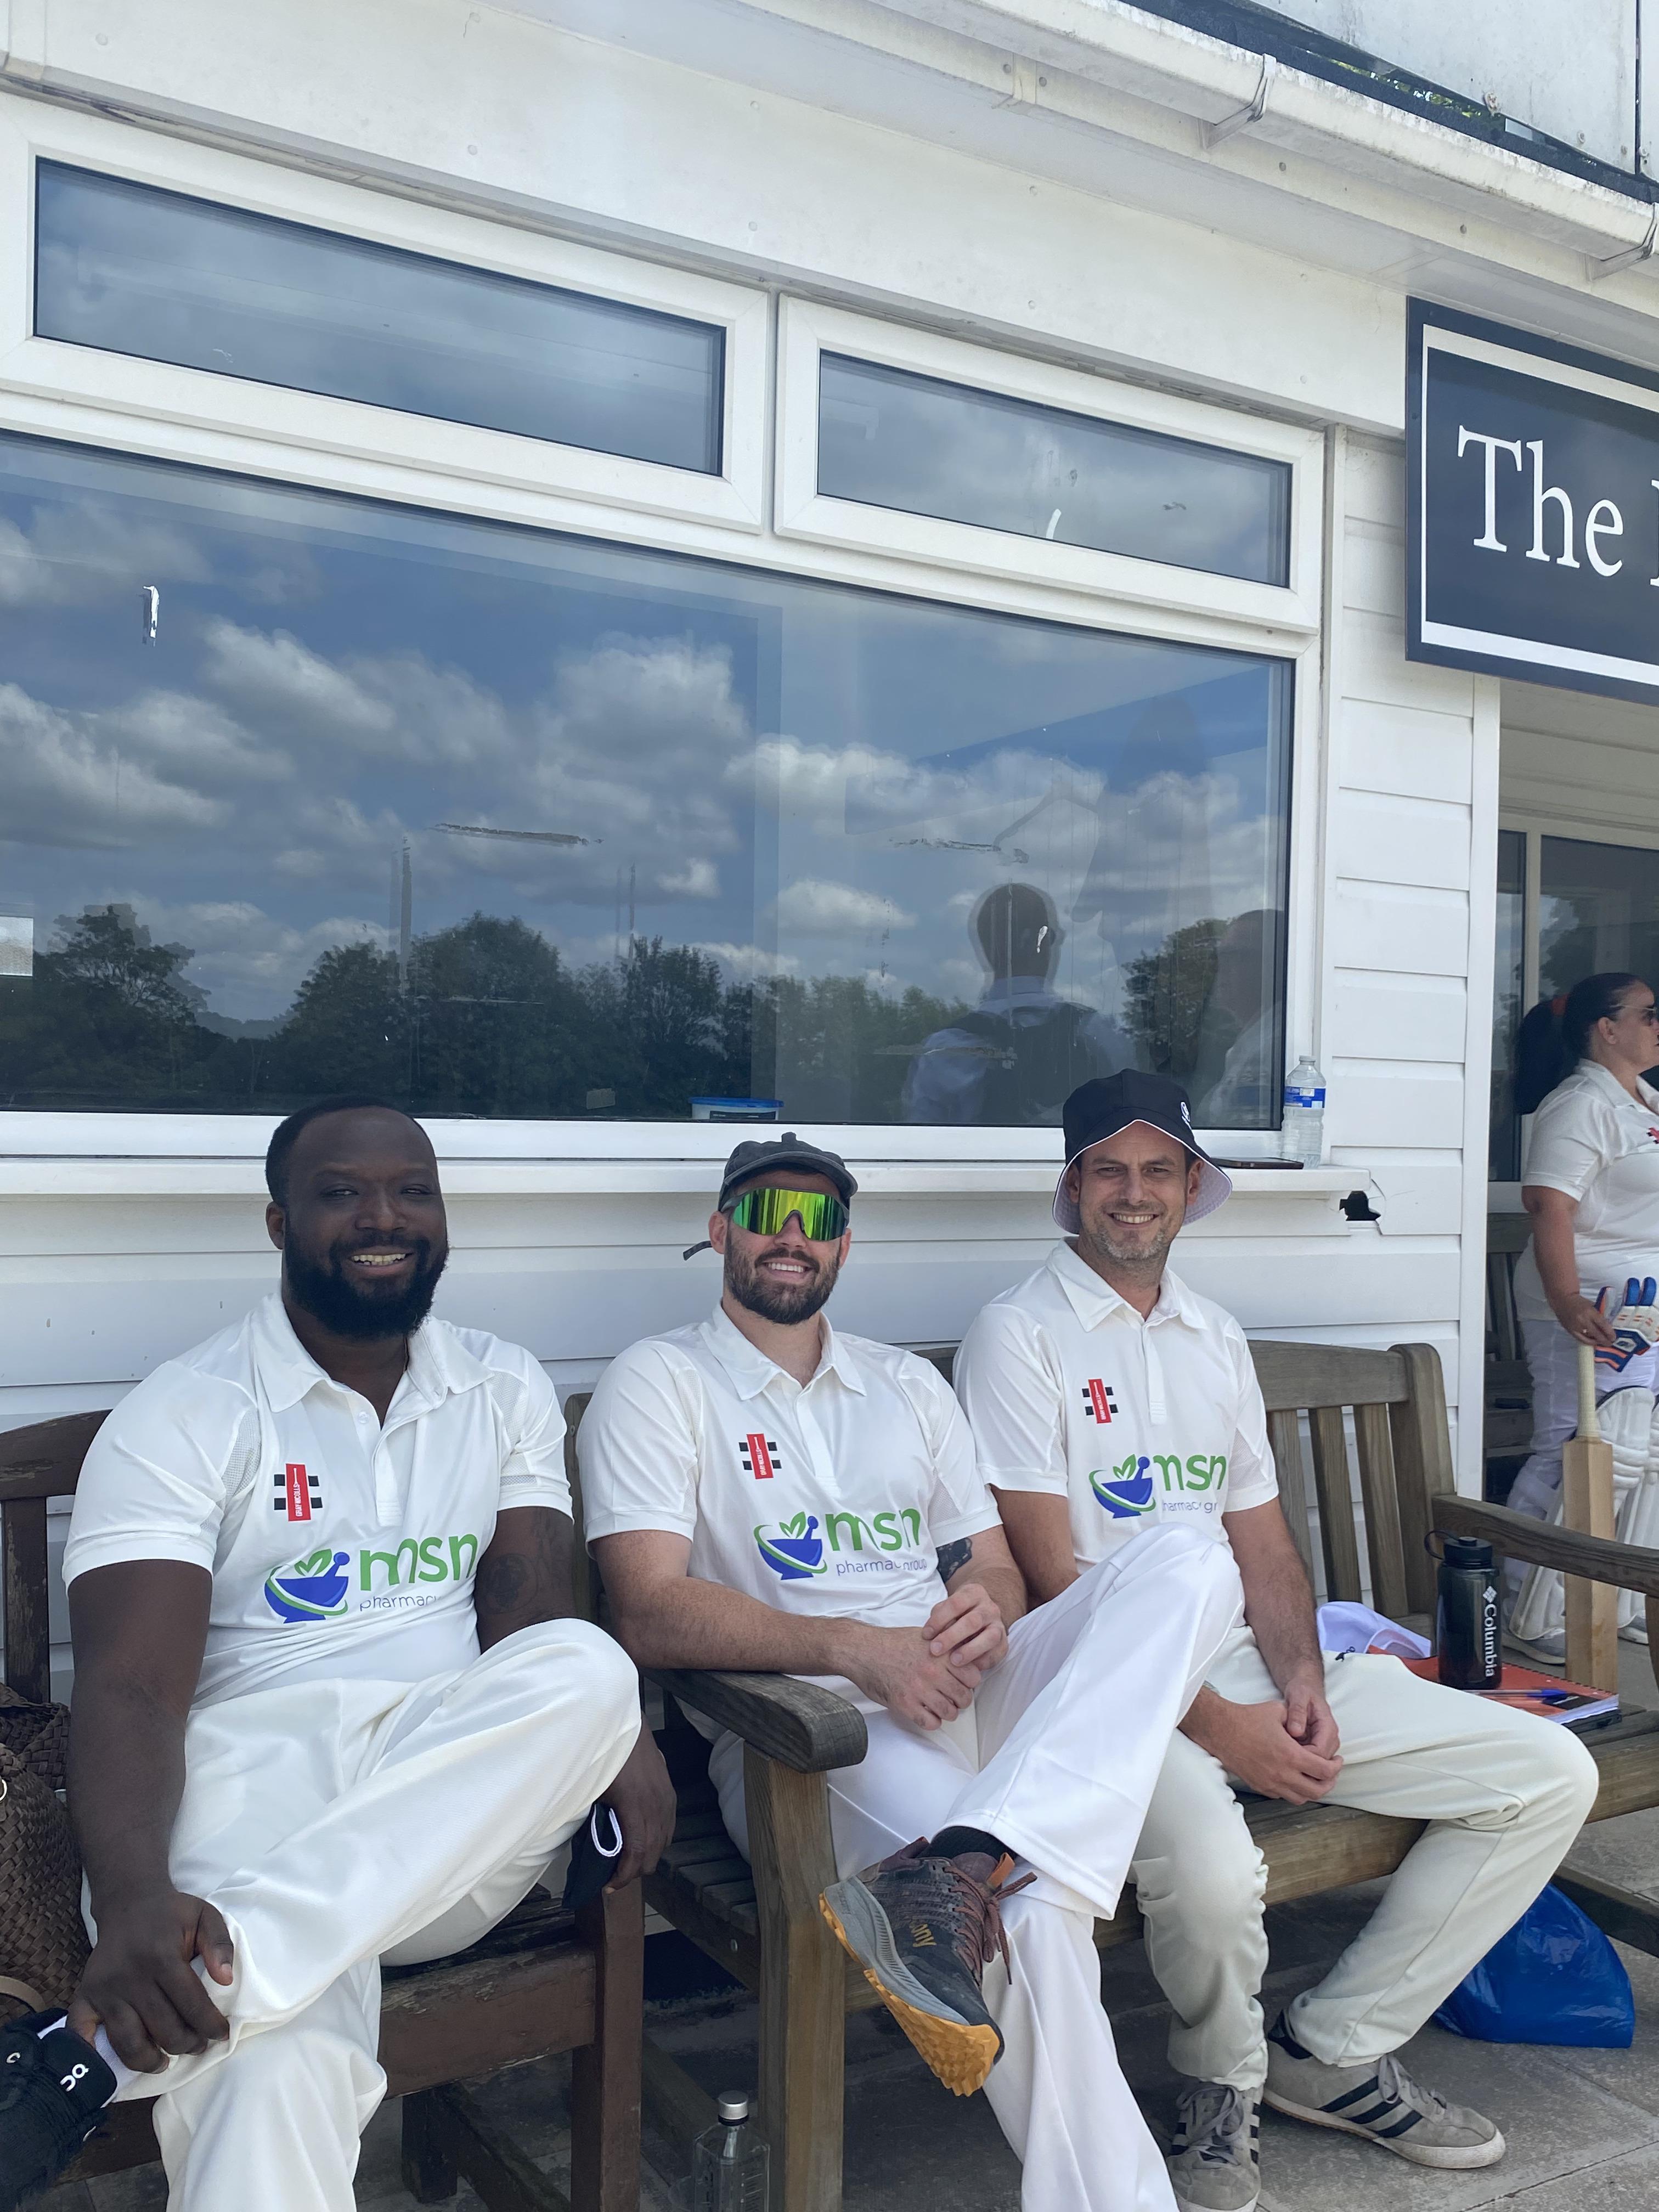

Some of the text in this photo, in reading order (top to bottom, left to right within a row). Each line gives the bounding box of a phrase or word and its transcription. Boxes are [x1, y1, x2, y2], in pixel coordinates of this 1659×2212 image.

[1458, 425, 1623, 577] The
[360, 1533, 478, 1592] msn
[825, 1508, 921, 1551] msn
[1483, 1603, 1498, 1677] Columbia
